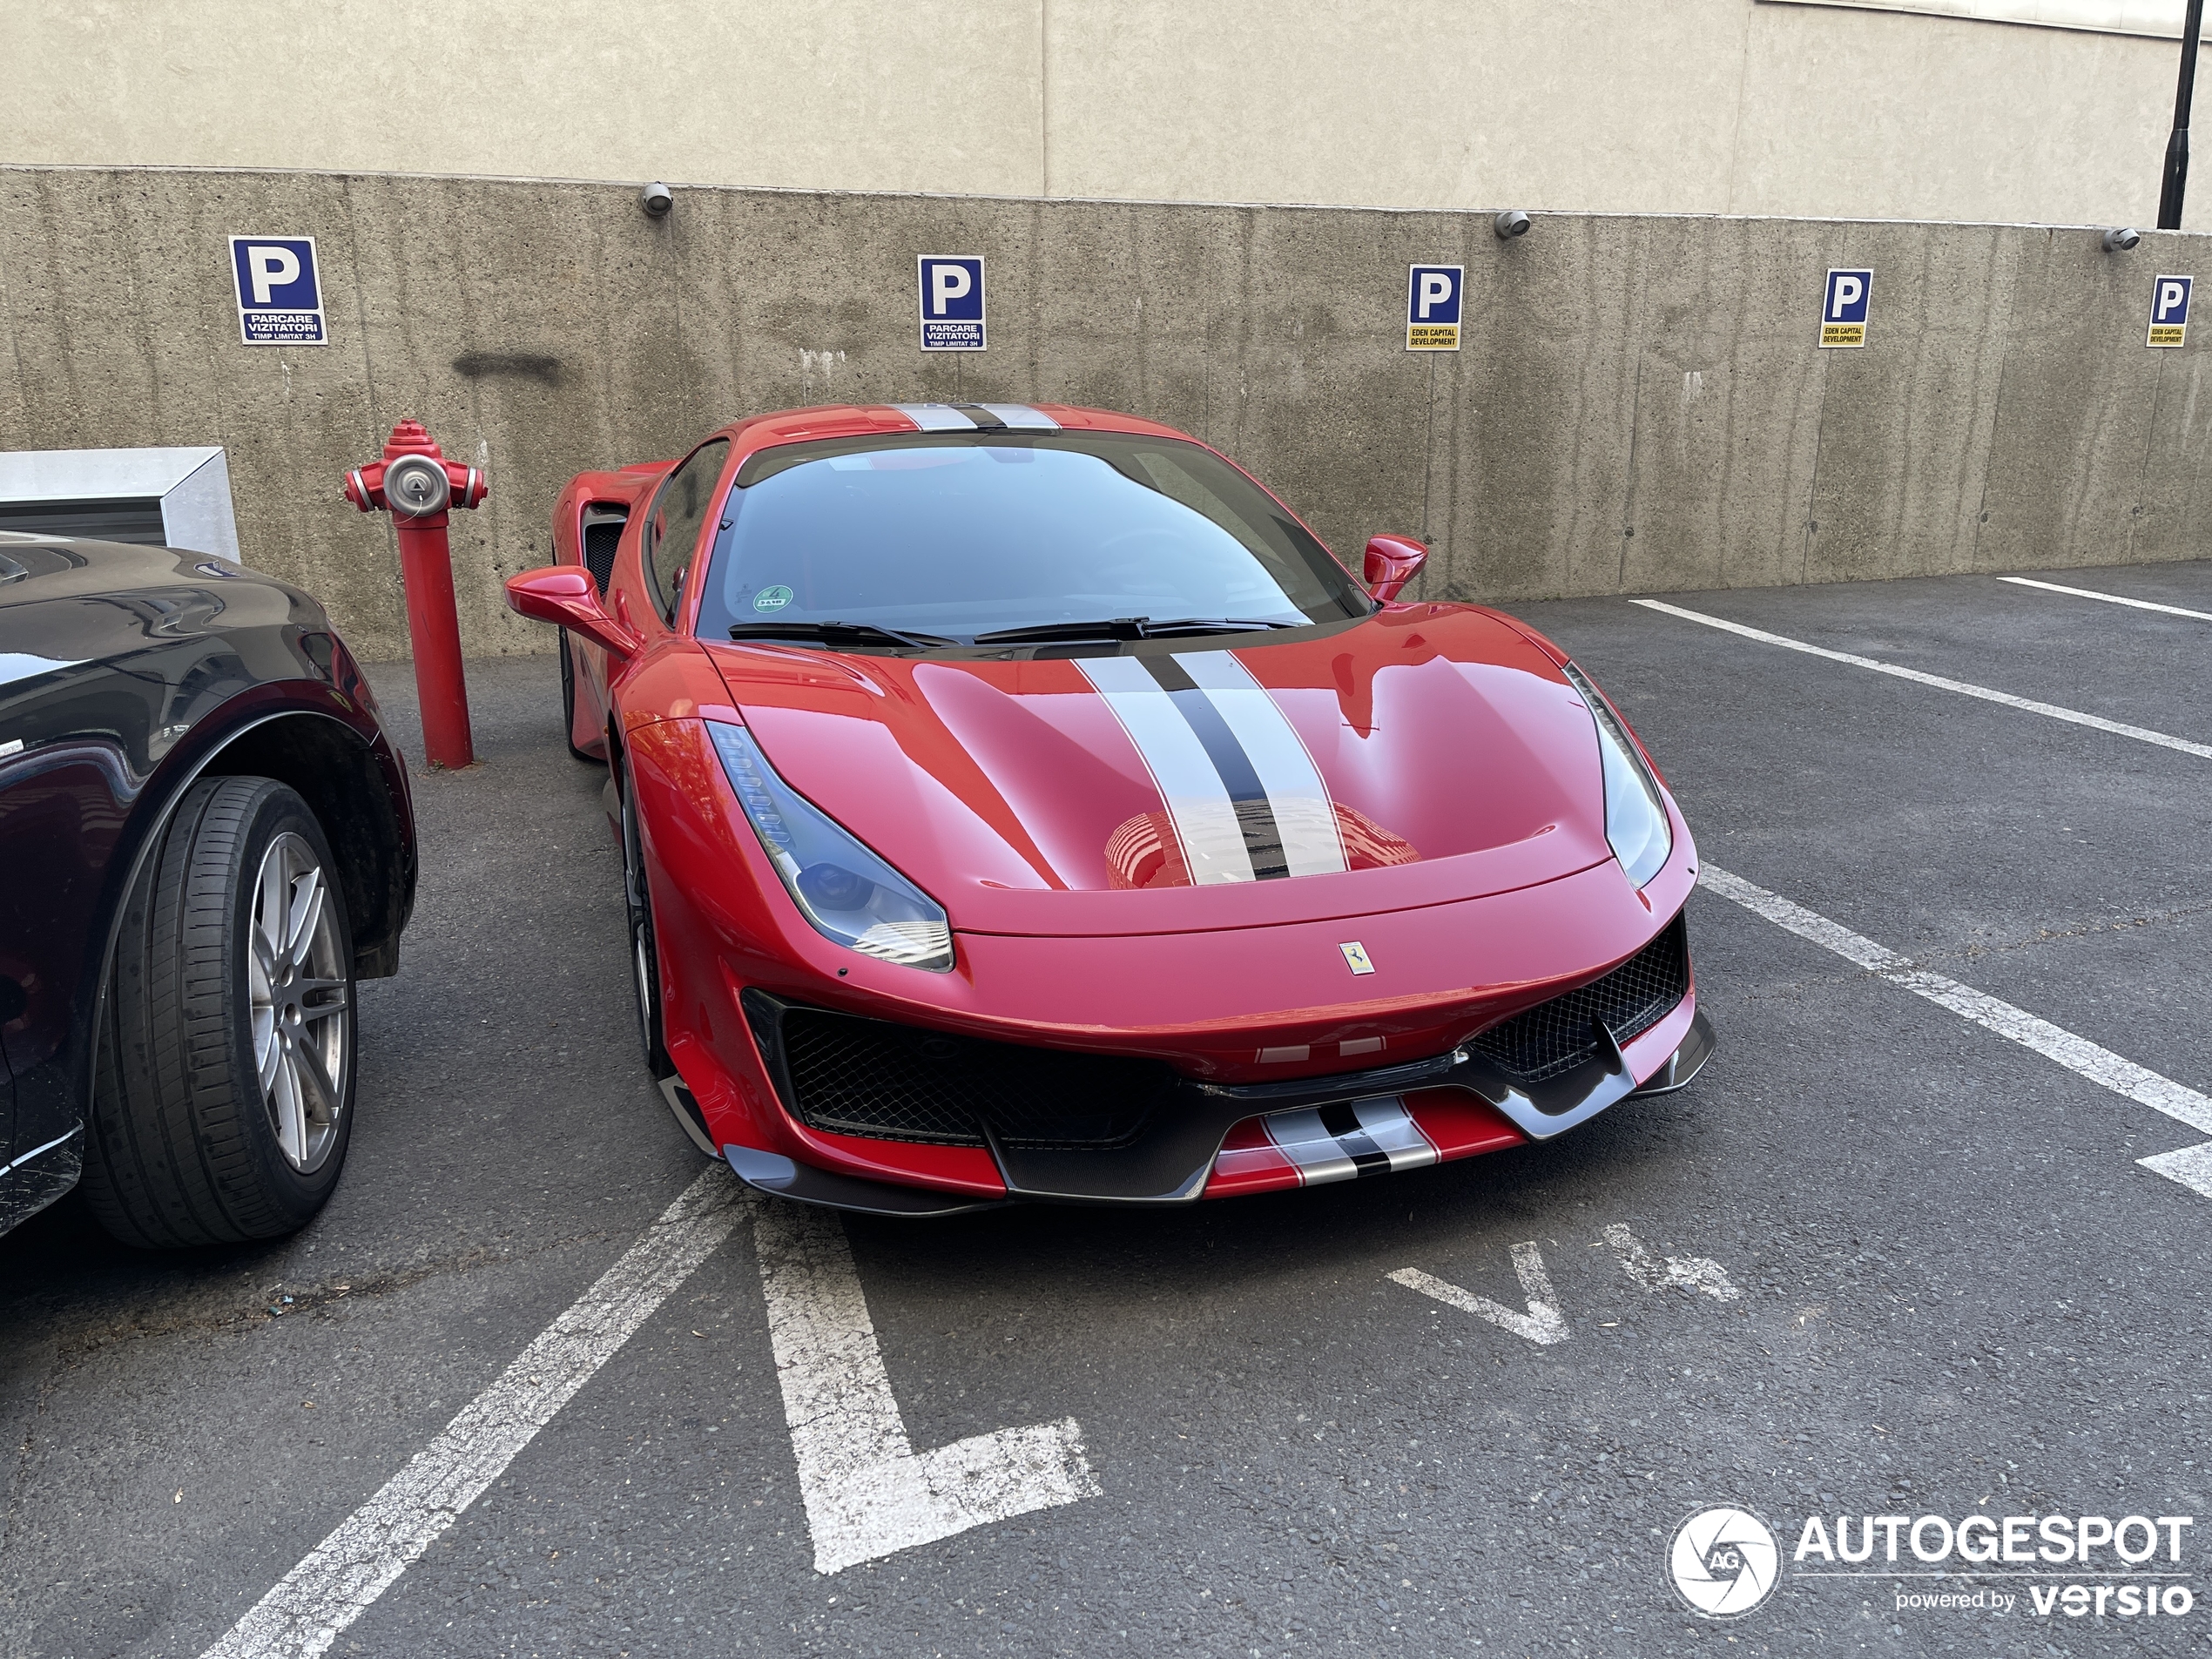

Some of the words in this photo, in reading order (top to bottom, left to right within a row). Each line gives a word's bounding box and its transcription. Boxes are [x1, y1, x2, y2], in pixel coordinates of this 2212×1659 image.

[247, 246, 300, 303] P
[932, 264, 971, 314] P
[1419, 273, 1453, 319] P
[1831, 276, 1863, 318] P
[2157, 282, 2184, 320] P
[247, 323, 318, 333] VIZITATORI
[251, 314, 314, 324] PARCARE
